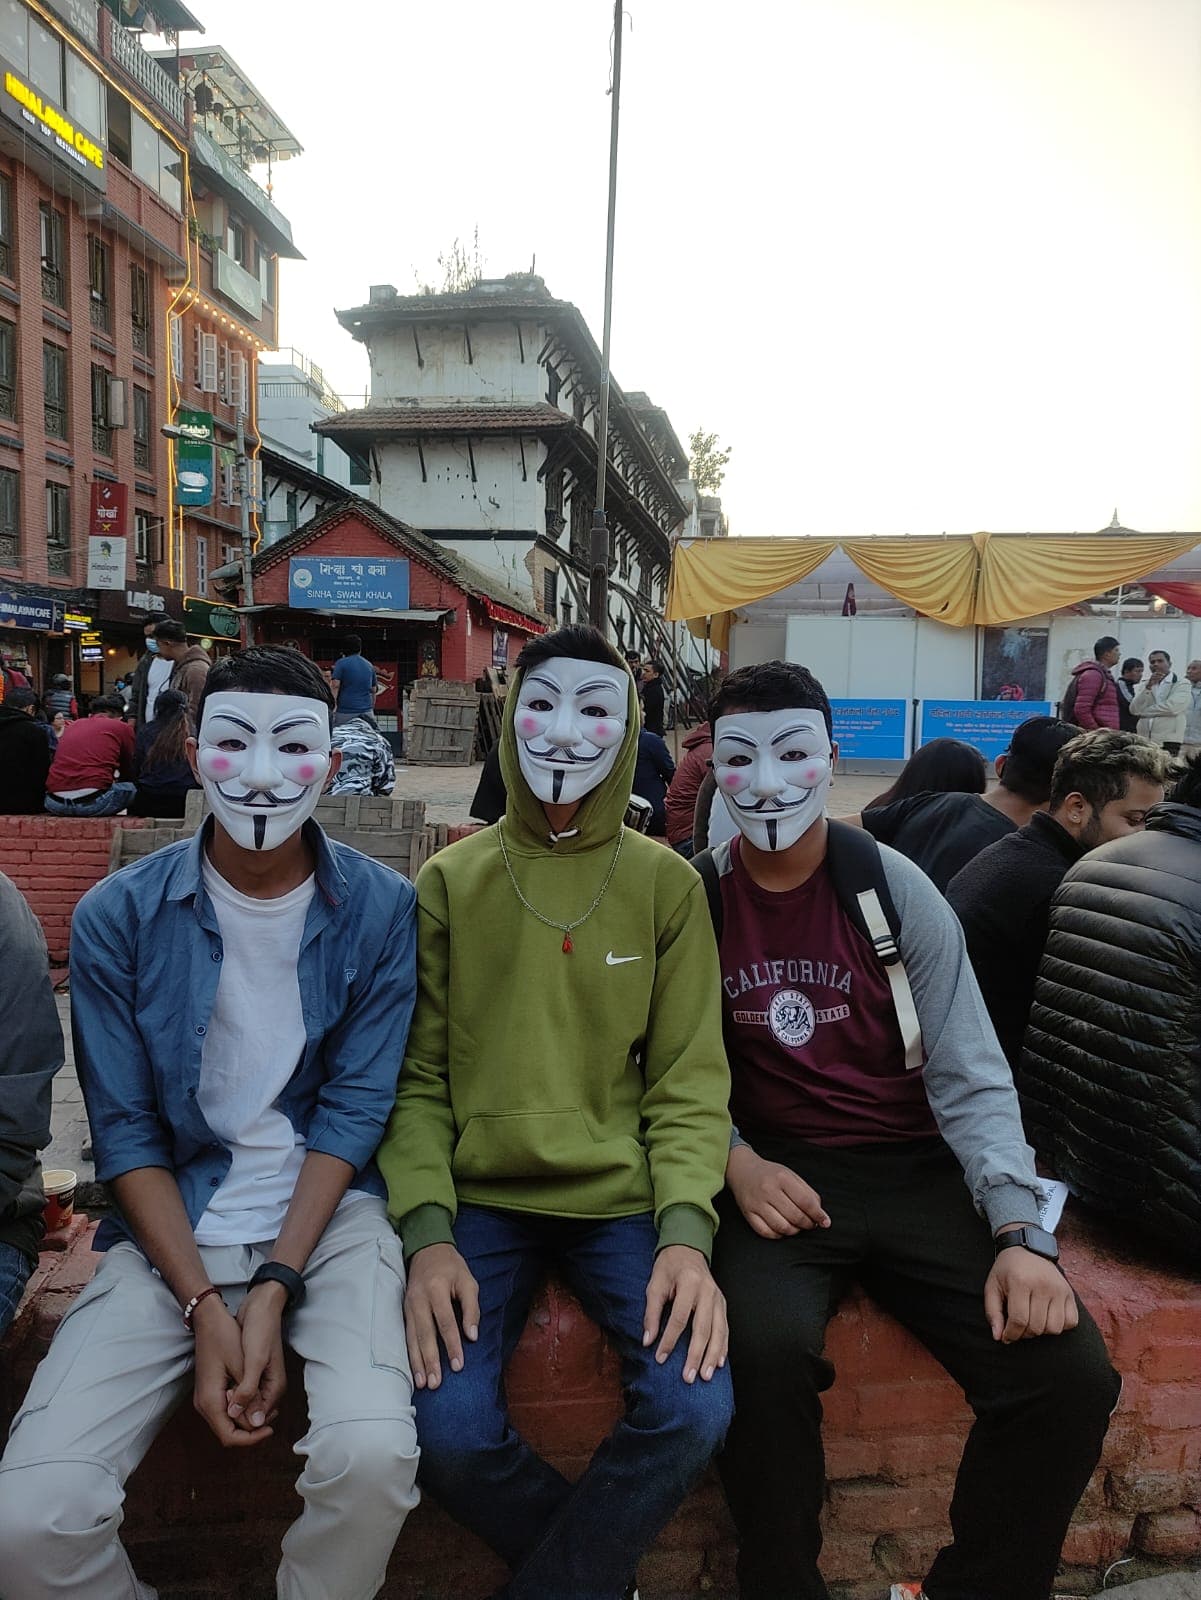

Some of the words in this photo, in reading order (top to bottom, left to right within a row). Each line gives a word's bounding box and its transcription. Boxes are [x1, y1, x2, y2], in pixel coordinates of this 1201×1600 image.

[55, 136, 87, 167] RESTAURANT
[75, 131, 104, 169] CAFE
[307, 590, 332, 598] SINHA
[336, 590, 361, 599] SWAN
[366, 591, 392, 600] KHALA
[35, 607, 52, 619] CAFE
[723, 959, 852, 999] CALIFORNIA
[736, 1012, 765, 1023] GOLDEN
[818, 1007, 848, 1022] STATE
